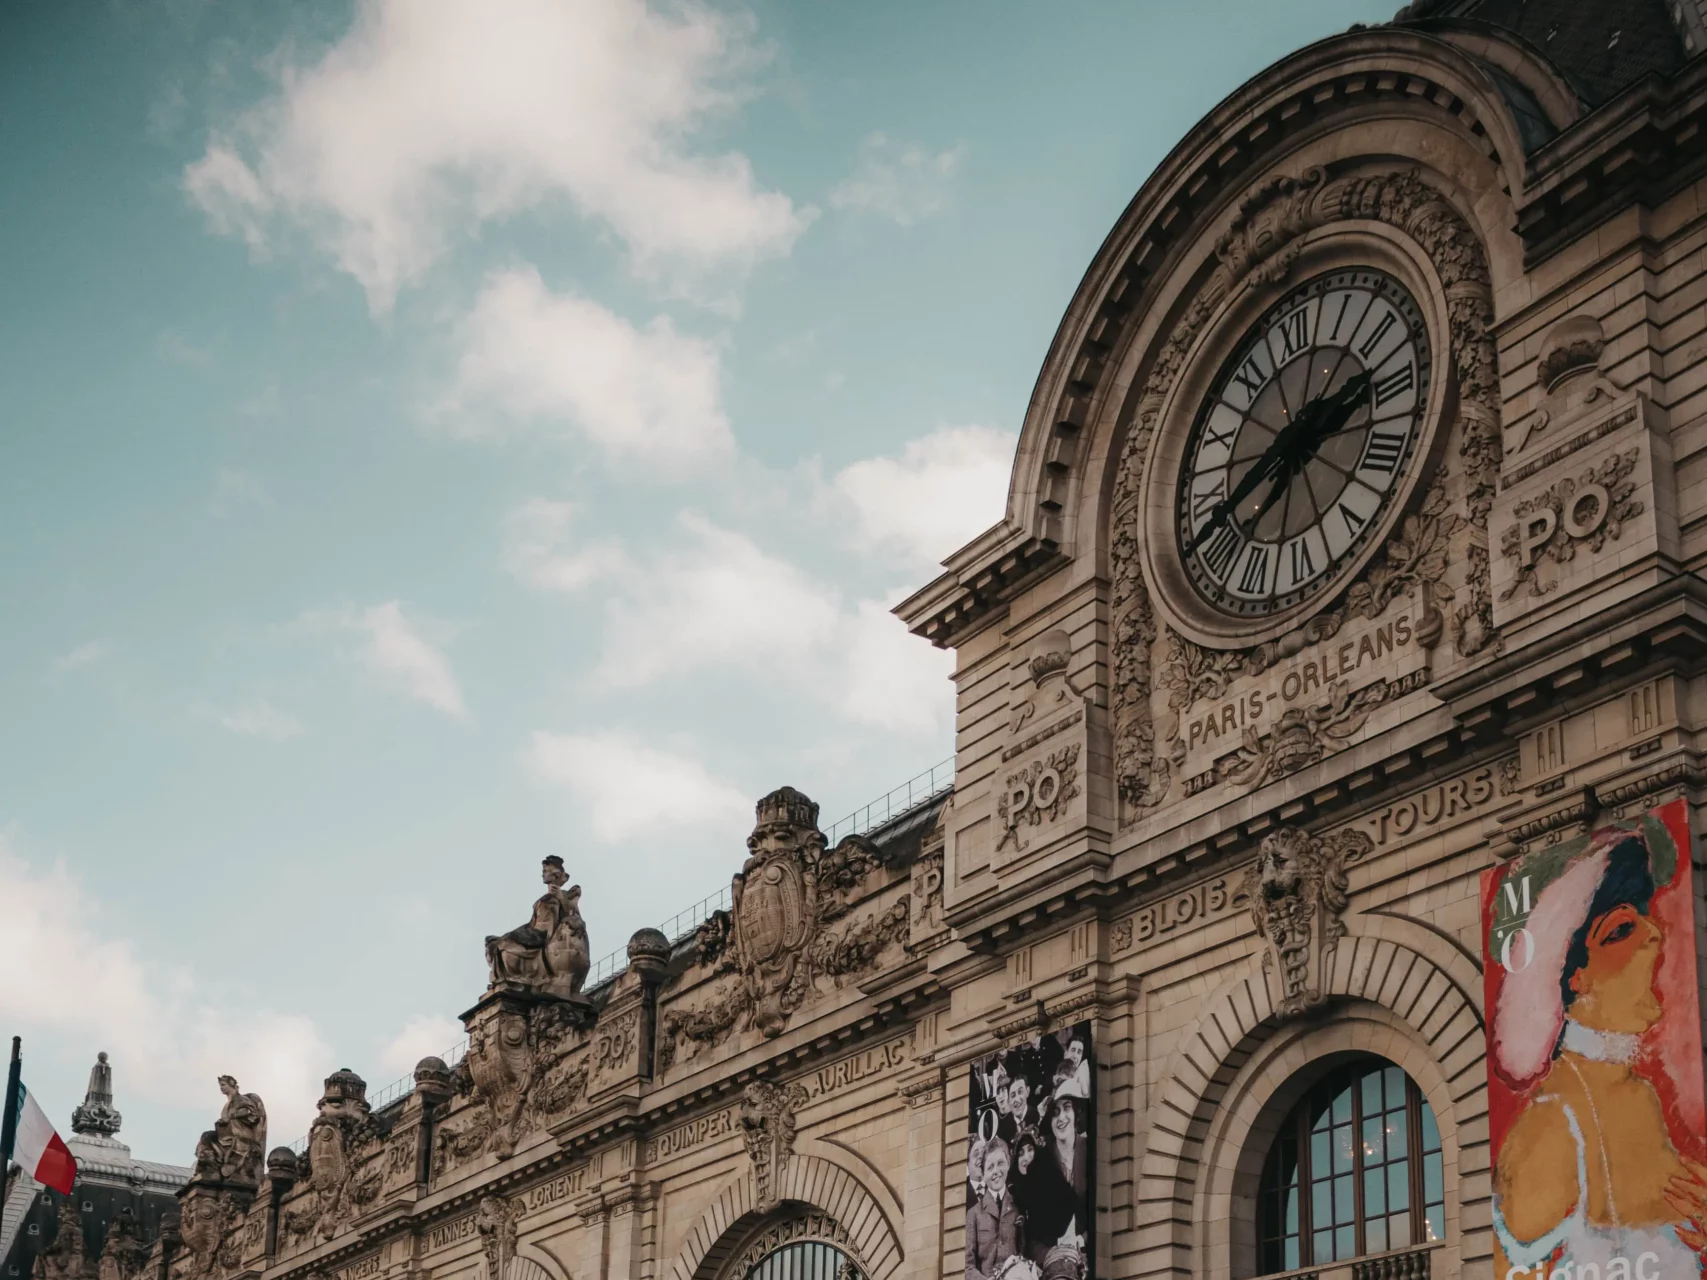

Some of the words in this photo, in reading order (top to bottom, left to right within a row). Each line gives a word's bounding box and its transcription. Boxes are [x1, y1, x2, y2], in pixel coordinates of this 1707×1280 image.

[1519, 484, 1610, 568] PO
[1188, 615, 1412, 750] PARIS-ORLEANS
[1008, 768, 1060, 828] PO
[1370, 769, 1493, 845] TOURS
[1137, 878, 1228, 942] BLOIS
[1501, 874, 1533, 920] M
[810, 1040, 905, 1098] AURILLAC
[660, 1110, 733, 1157] QUIMPER
[528, 1170, 585, 1210] LORIENT
[432, 1214, 477, 1248] VANNES
